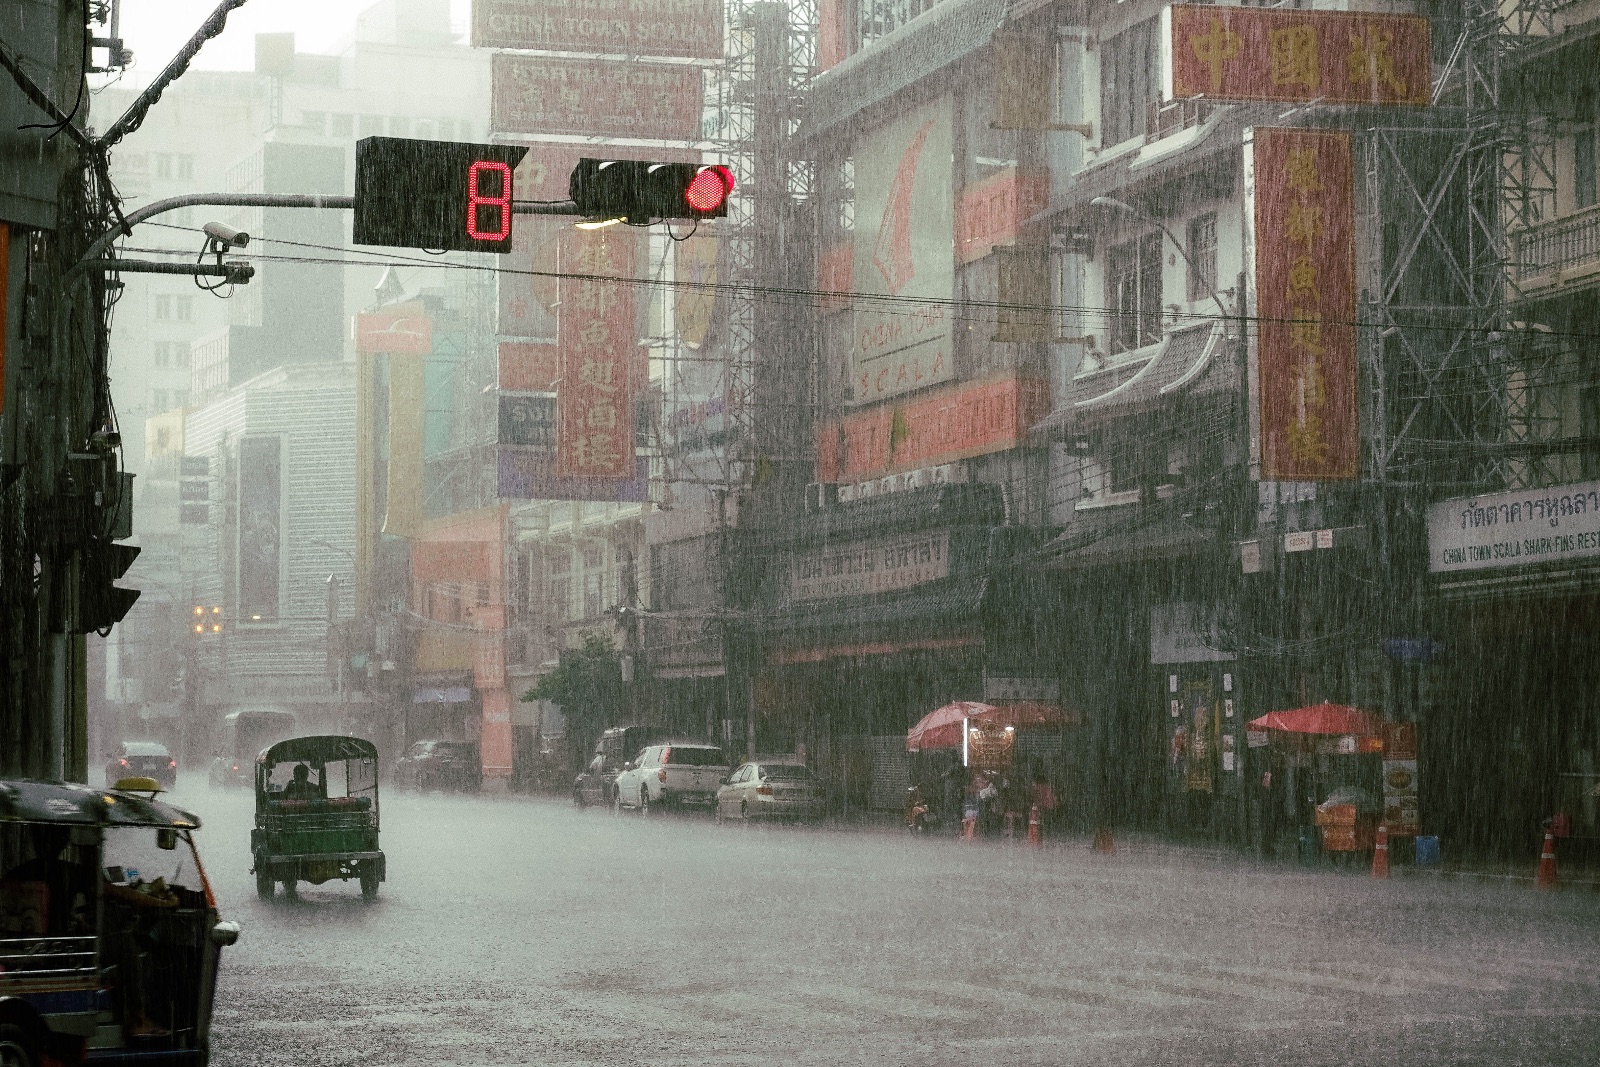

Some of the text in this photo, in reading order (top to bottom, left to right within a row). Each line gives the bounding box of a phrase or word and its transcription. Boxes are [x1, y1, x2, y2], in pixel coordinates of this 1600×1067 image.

[488, 12, 558, 36] CHINA
[564, 17, 633, 40] TOWN
[466, 160, 511, 241] 8
[860, 318, 904, 354] CHINA
[859, 349, 946, 397] SCALA
[1443, 547, 1467, 565] CHINA
[1468, 544, 1492, 563] TOWN
[1493, 540, 1522, 560] SCALA
[1523, 536, 1553, 557] SHARK
[1554, 534, 1575, 553] FINS
